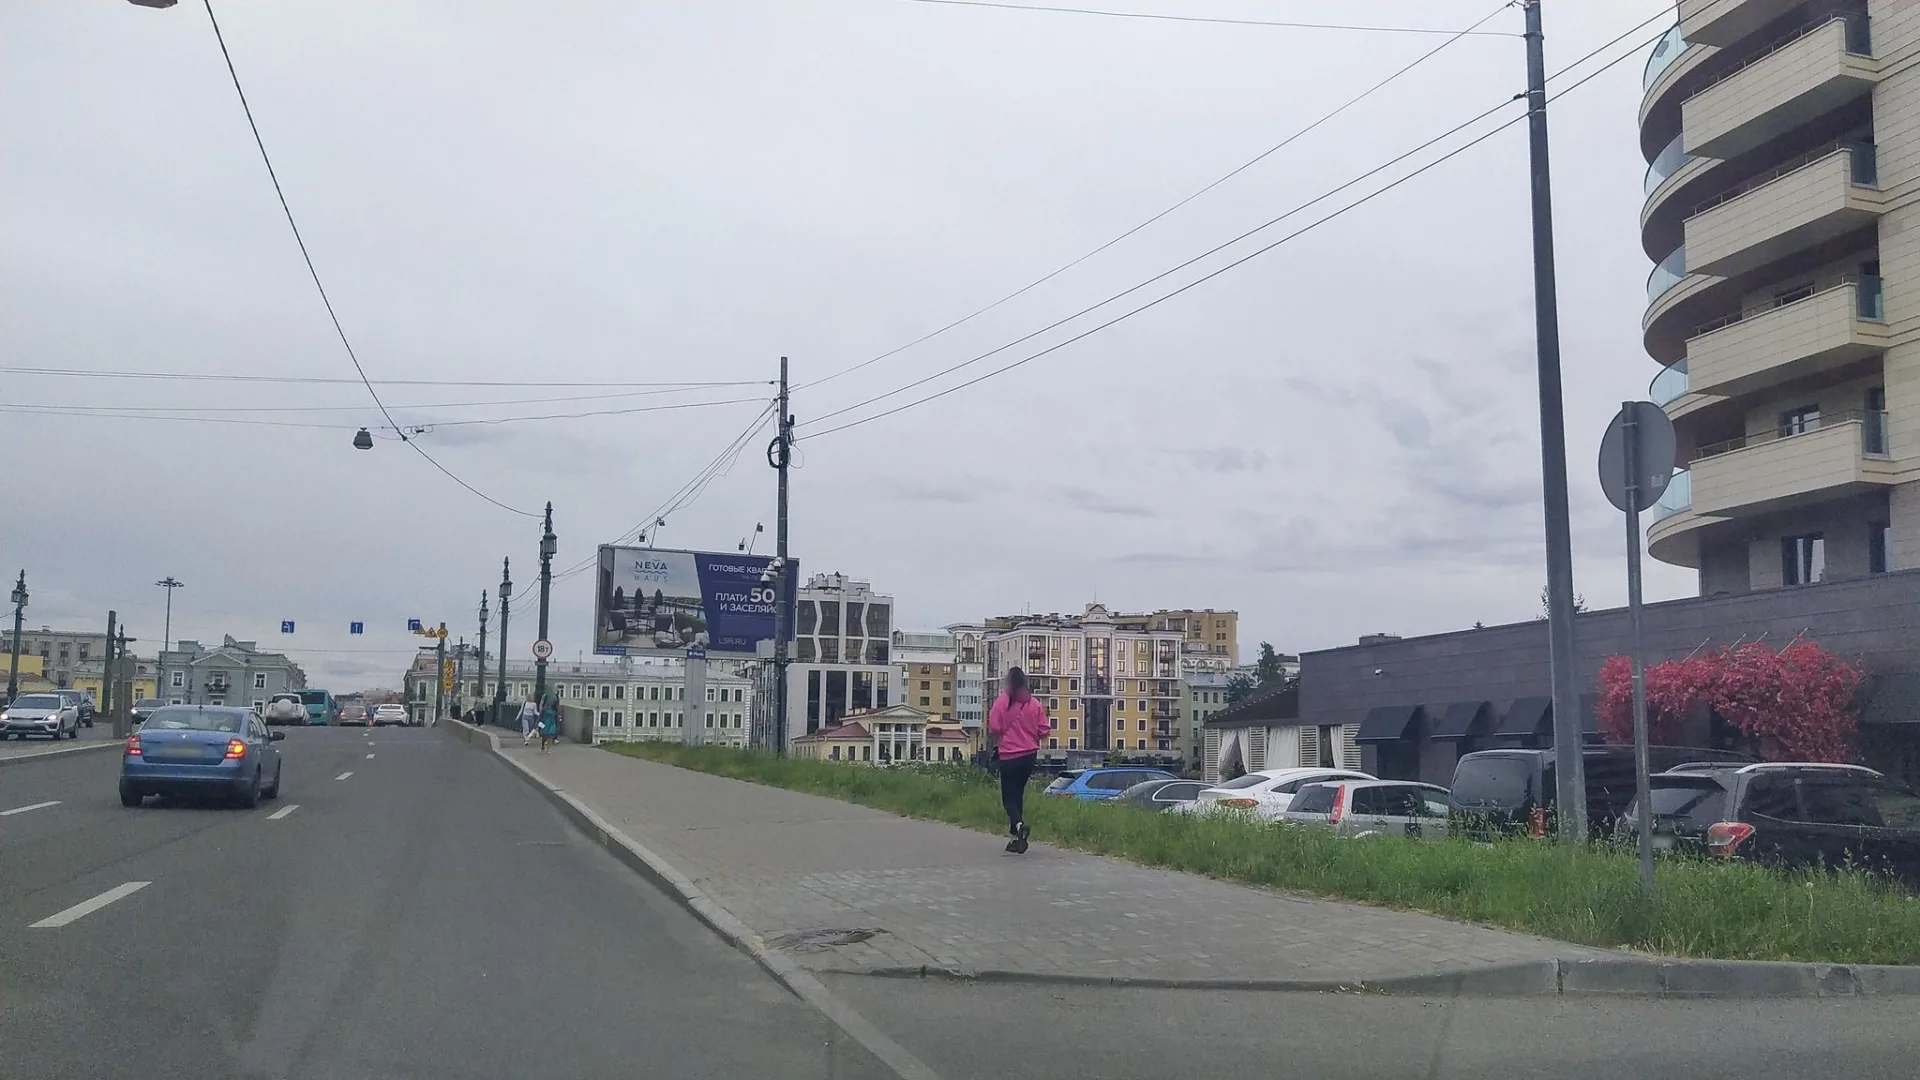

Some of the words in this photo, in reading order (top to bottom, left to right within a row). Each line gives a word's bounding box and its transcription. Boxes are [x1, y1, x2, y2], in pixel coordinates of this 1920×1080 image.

[635, 561, 668, 570] NEVA
[709, 564, 745, 573] ГОТОВЫЕ
[715, 592, 747, 602] ПЛАТИ
[750, 587, 775, 604] 50
[720, 603, 727, 611] И
